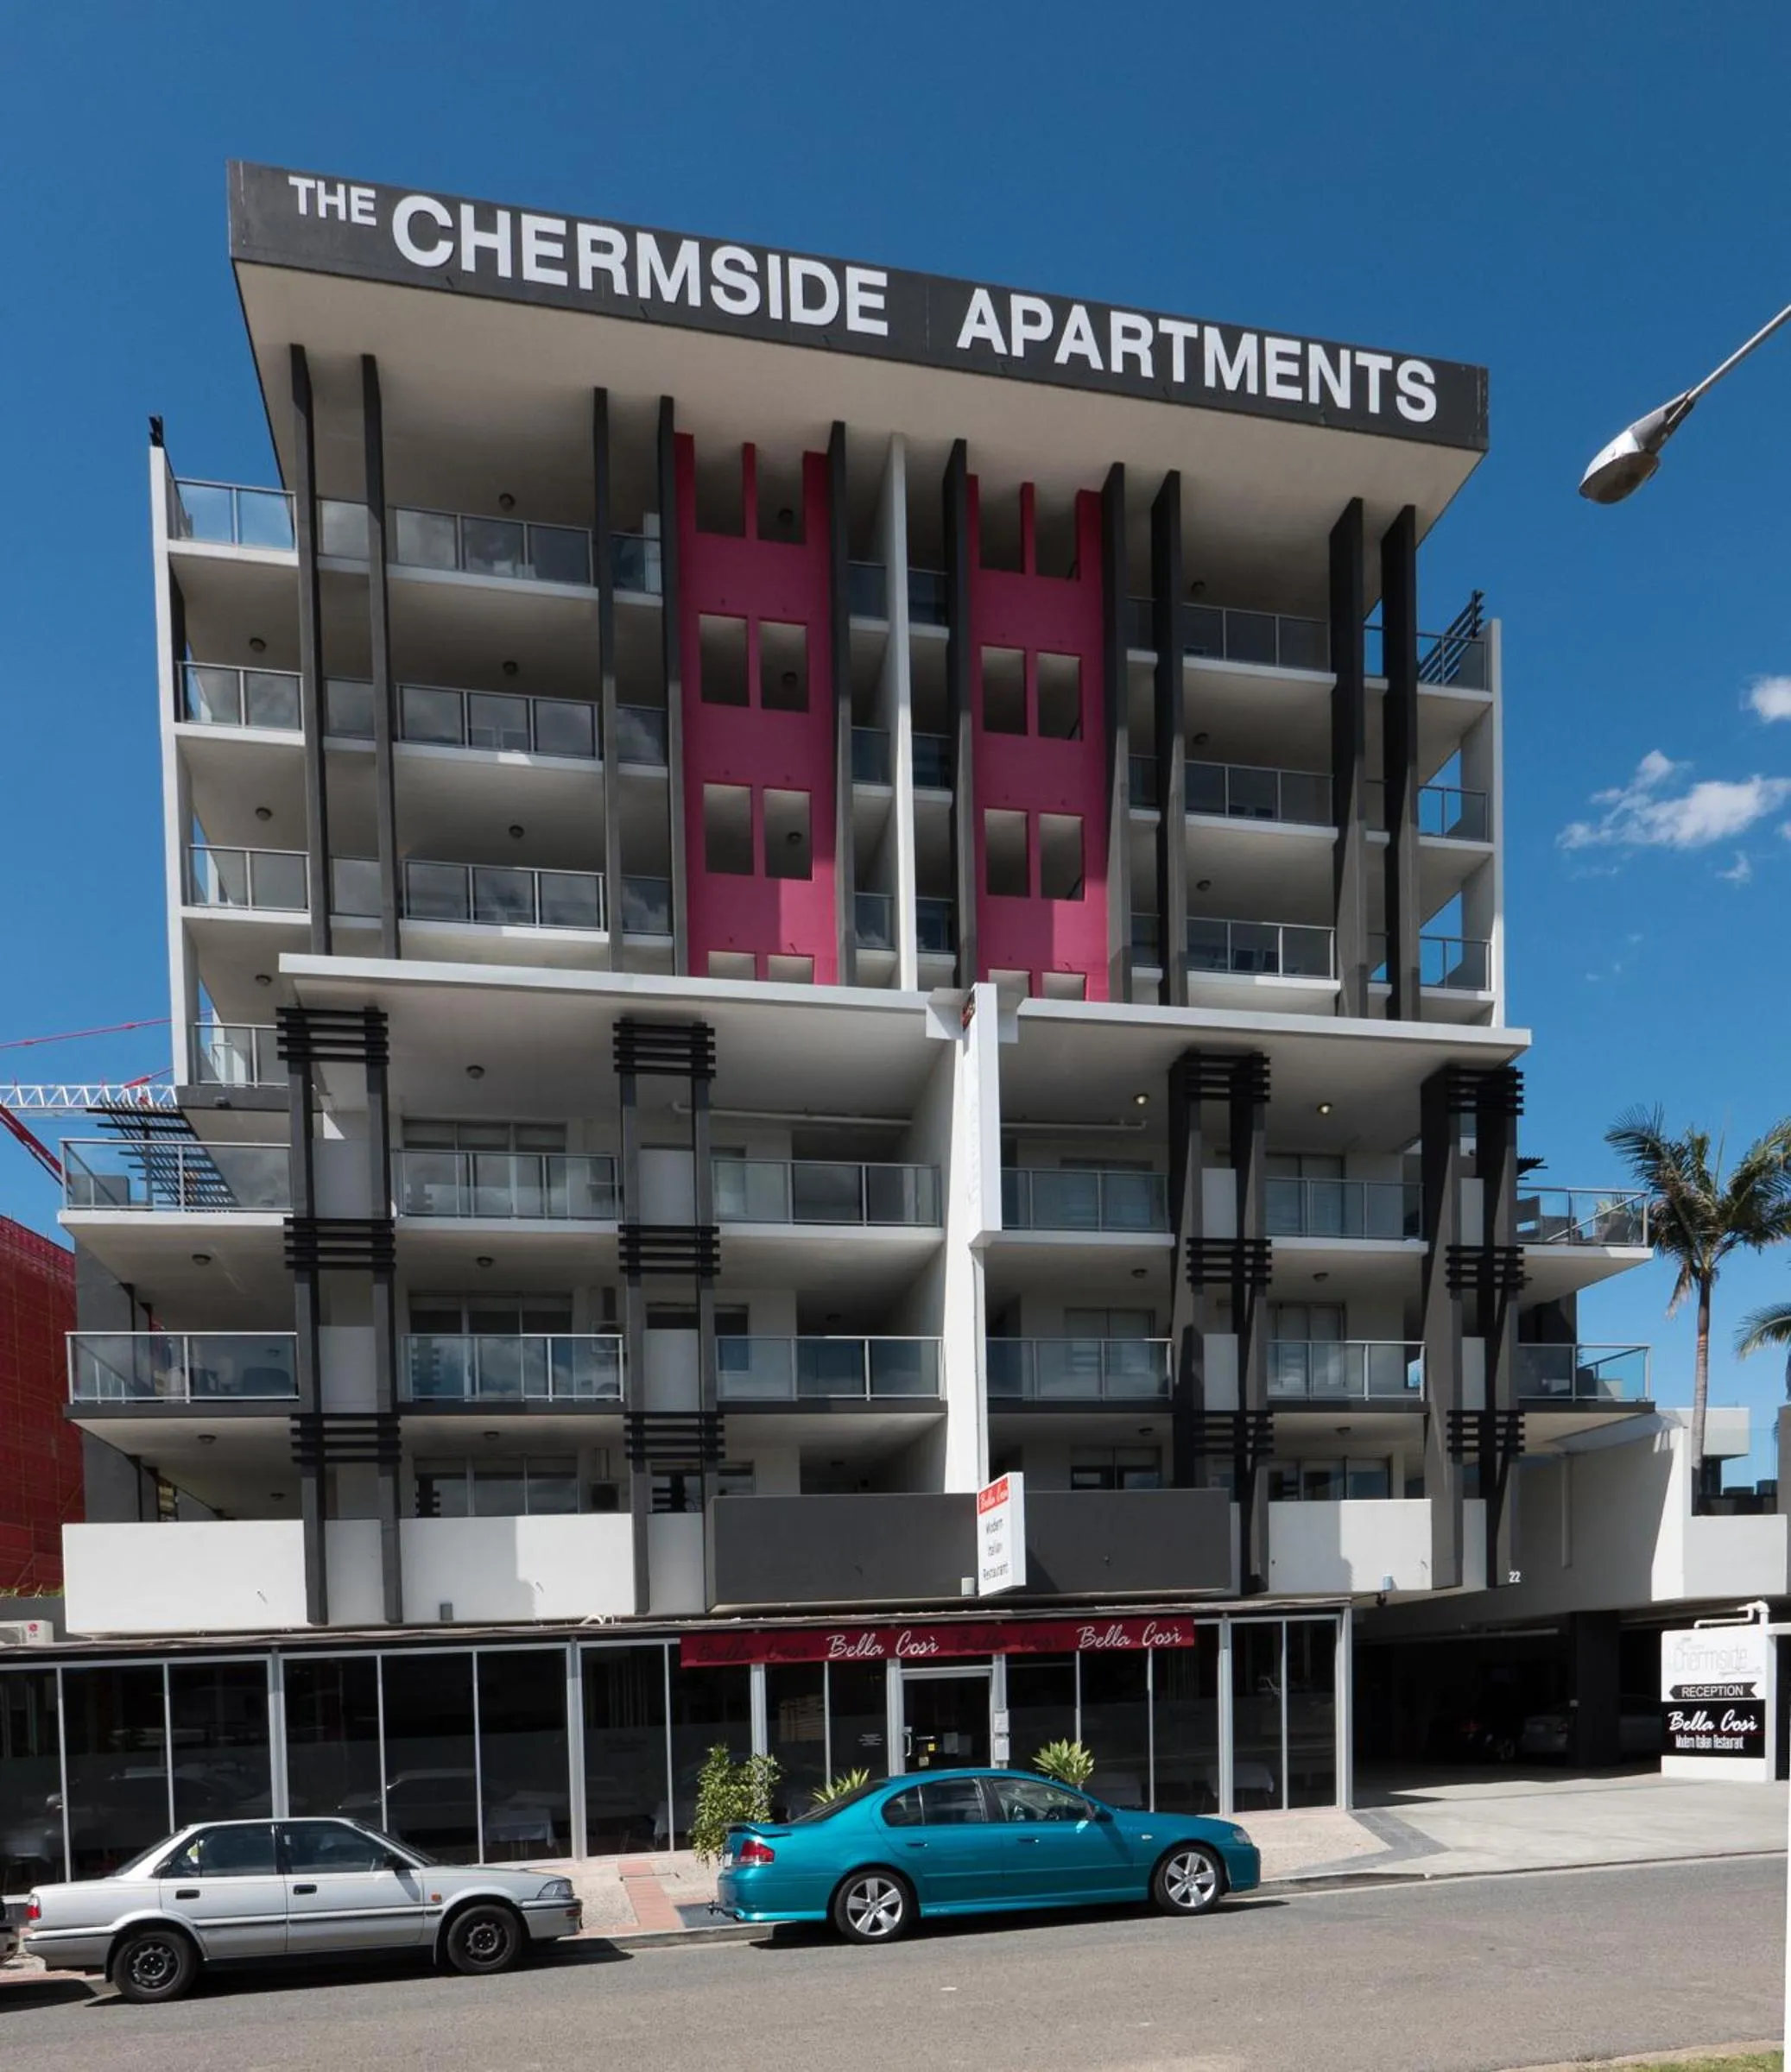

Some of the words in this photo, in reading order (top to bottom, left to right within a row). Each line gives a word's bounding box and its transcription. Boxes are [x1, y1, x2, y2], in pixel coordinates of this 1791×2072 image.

[288, 176, 377, 226] THE
[392, 194, 889, 337] CHERMSIDE
[956, 287, 1437, 423] APARTMENTS
[1509, 1570, 1521, 1583] 22
[826, 1631, 884, 1658] Bella
[1076, 1623, 1131, 1649] Bella
[1681, 1684, 1744, 1697] RECEPTION
[1668, 1709, 1714, 1731] Bella
